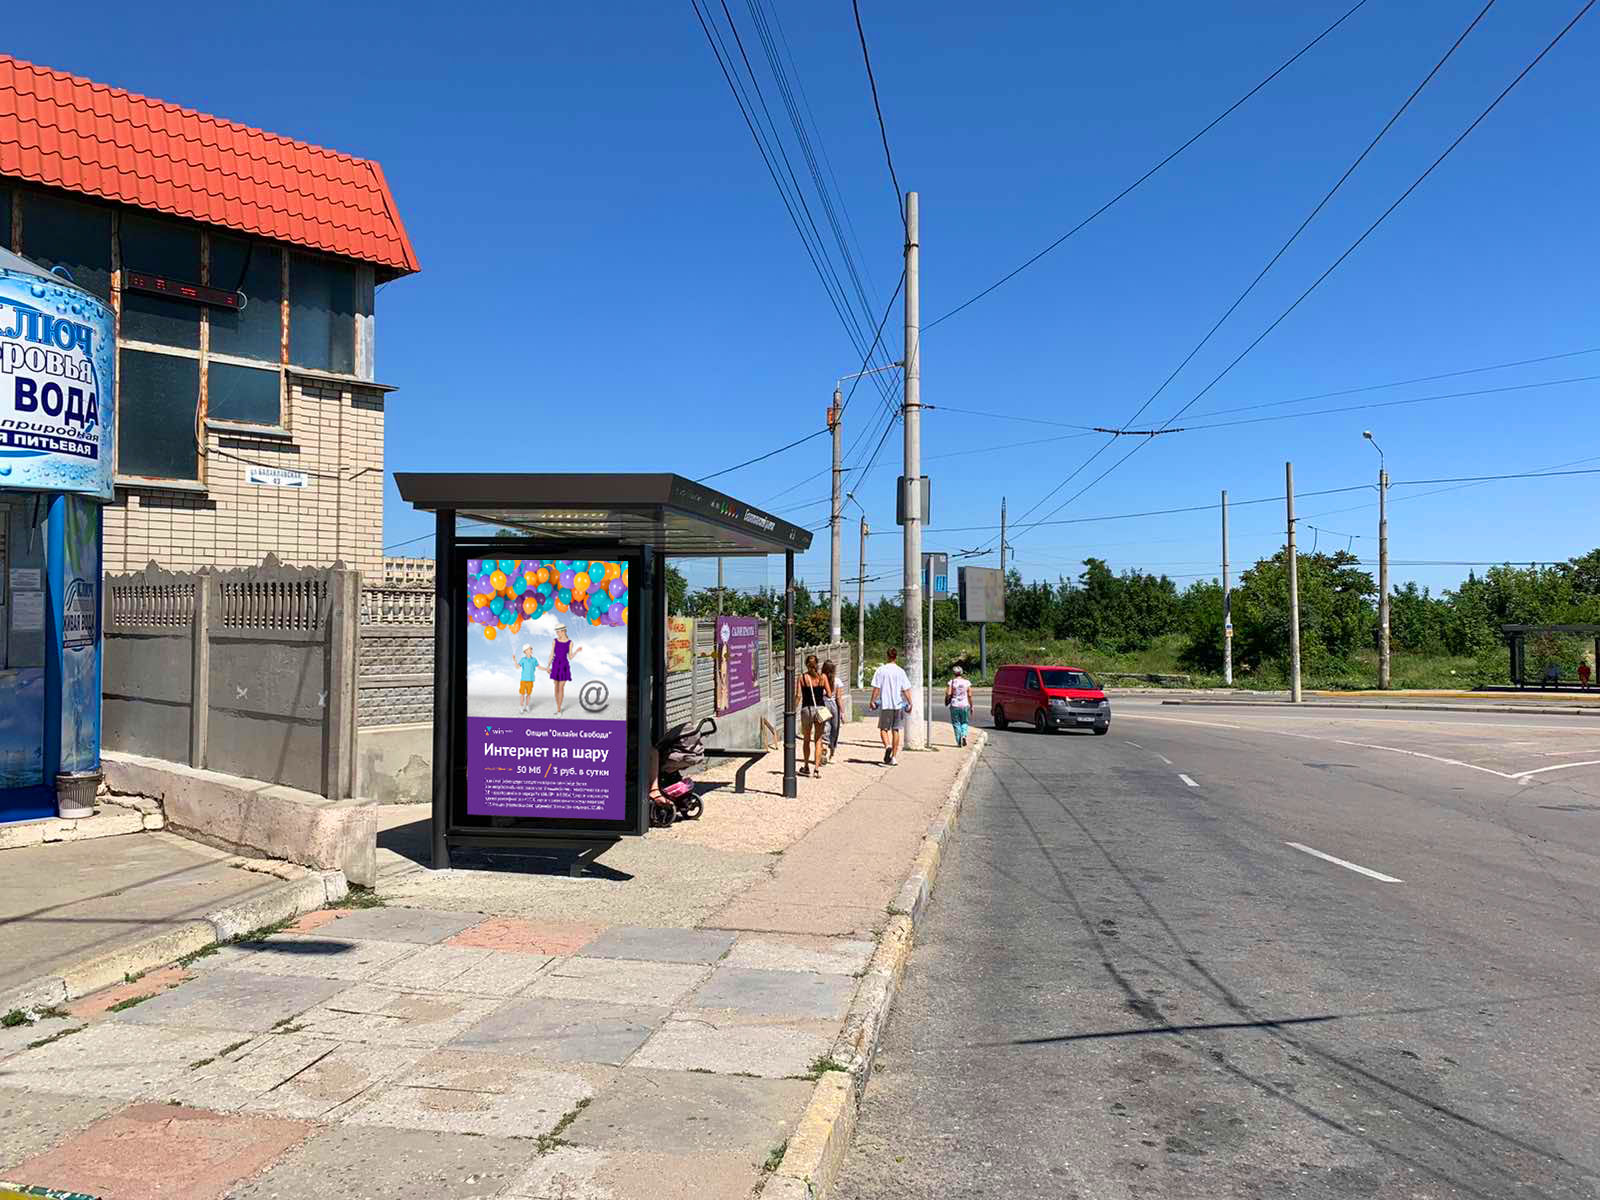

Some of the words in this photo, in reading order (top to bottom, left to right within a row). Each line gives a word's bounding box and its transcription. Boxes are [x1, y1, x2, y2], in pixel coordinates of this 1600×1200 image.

[0, 304, 93, 358] ЛЮЧ
[0, 341, 92, 384] ровья
[15, 375, 99, 429] ВОДА
[1, 419, 99, 442] природная
[13, 433, 92, 456] ПИТЬЕВАЯ
[525, 728, 549, 738] Опция
[484, 742, 549, 760] Интернет
[552, 748, 569, 759] на
[572, 748, 609, 763] шару
[516, 765, 527, 774] 50
[528, 765, 541, 774] Мб
[559, 767, 577, 777] руб.
[579, 768, 584, 776] в
[585, 769, 610, 778] сутки
